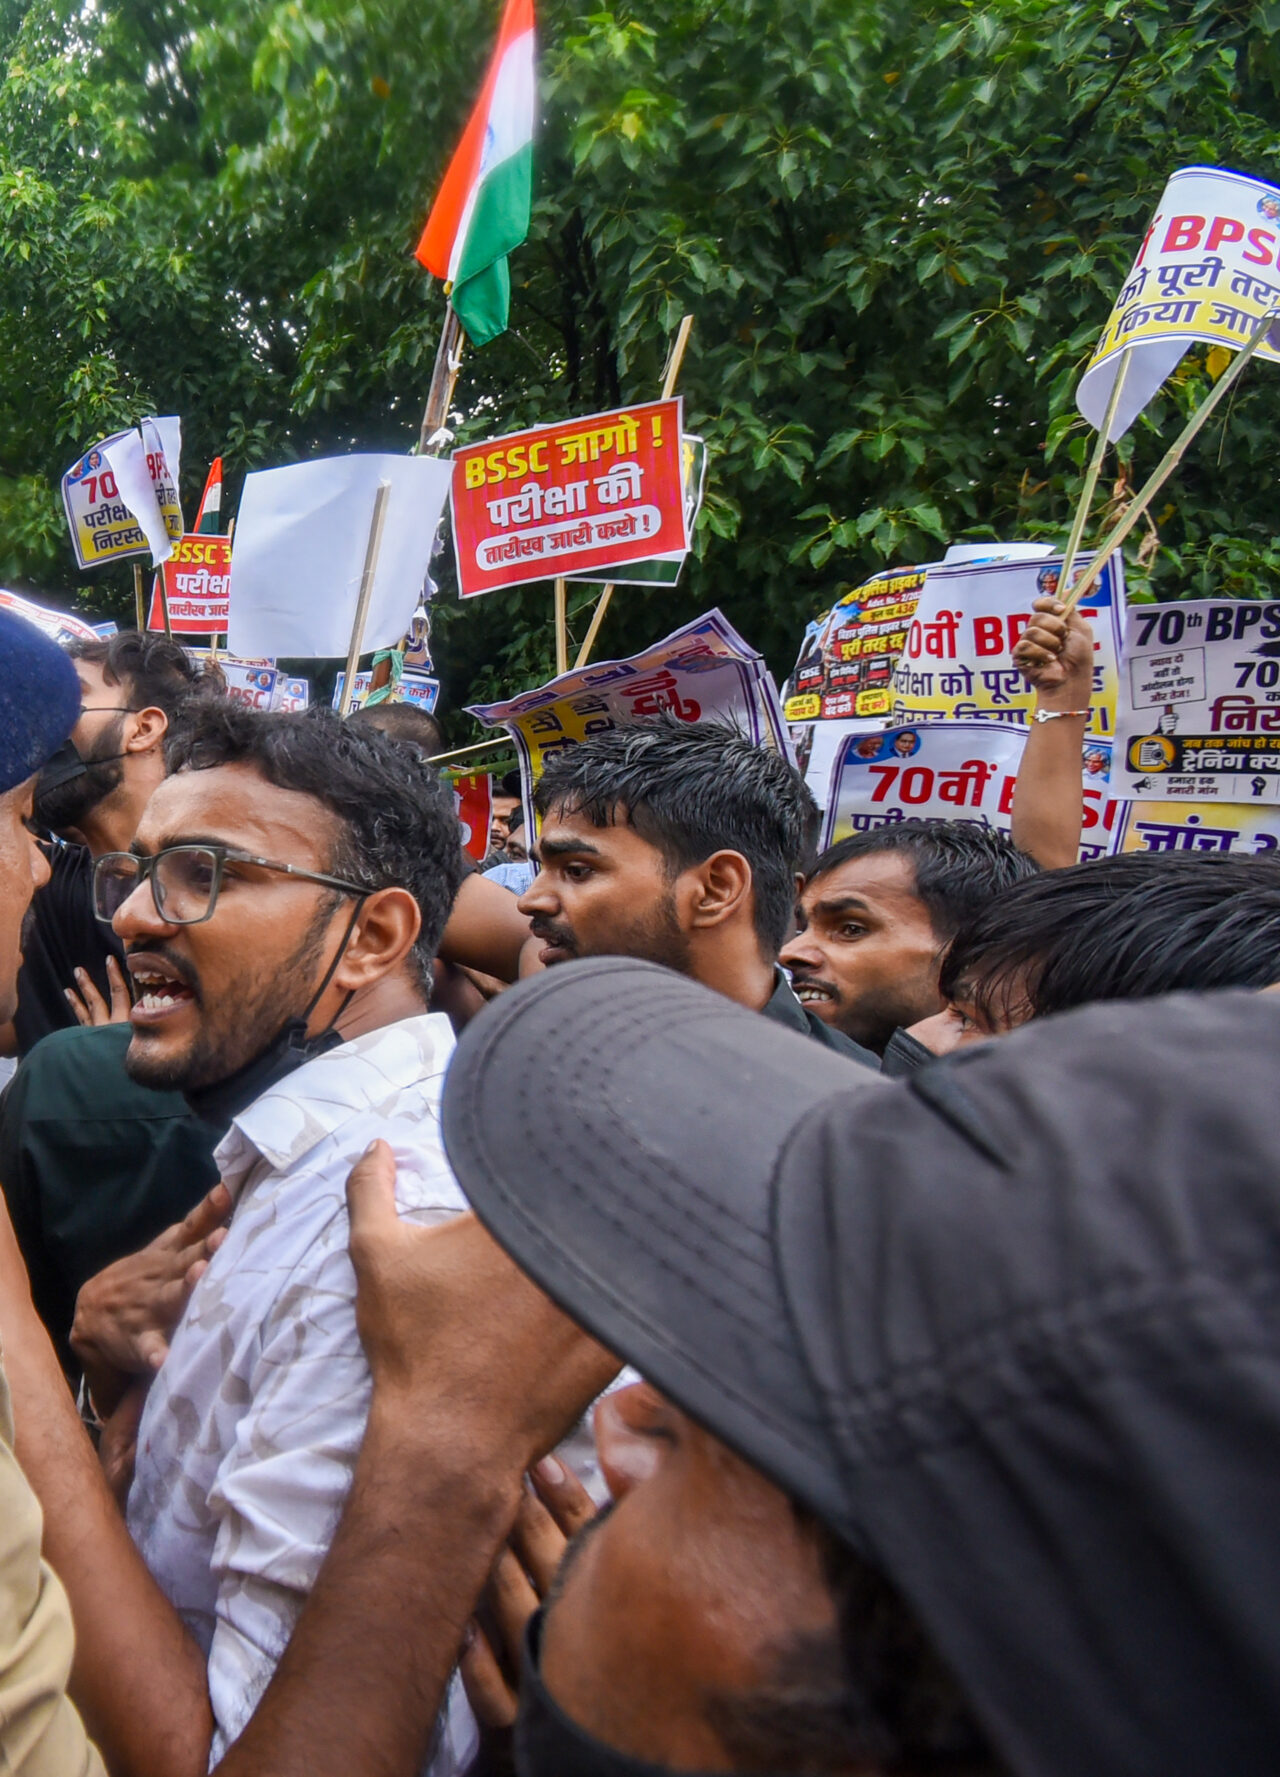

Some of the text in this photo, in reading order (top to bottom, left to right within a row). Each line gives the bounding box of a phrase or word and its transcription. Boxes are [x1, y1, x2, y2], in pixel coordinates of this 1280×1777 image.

[1160, 215, 1280, 272] BPS
[1158, 257, 1225, 296] पूरी
[1230, 269, 1280, 307] तर
[1114, 302, 1201, 342] किया
[465, 441, 549, 489] BSSC
[555, 415, 640, 465] जागो
[81, 471, 119, 504] 70
[487, 481, 588, 528] परीक्षा
[594, 461, 644, 504] की
[92, 527, 144, 552] निरस्त
[168, 542, 217, 564] BSSC
[484, 536, 543, 565] तारीख
[549, 522, 592, 549] जारी
[596, 512, 635, 540] करो
[168, 601, 229, 616] तारीख जार
[1135, 604, 1280, 646] 70th BPS
[841, 638, 862, 661] पूरी
[863, 637, 888, 654] तरह
[908, 610, 963, 659] 0वीं
[939, 664, 974, 697] को
[1234, 661, 1280, 688] 70
[223, 686, 265, 709] PSC
[282, 698, 300, 713] SC
[1209, 695, 1280, 731] निर
[1182, 737, 1280, 748] जब तक जांच हो रह
[1182, 750, 1280, 772] ट्रेनिंग क्य
[868, 760, 998, 807] 70वीं
[1167, 785, 1218, 795] हमारी मांग
[1199, 776, 1214, 784] हक
